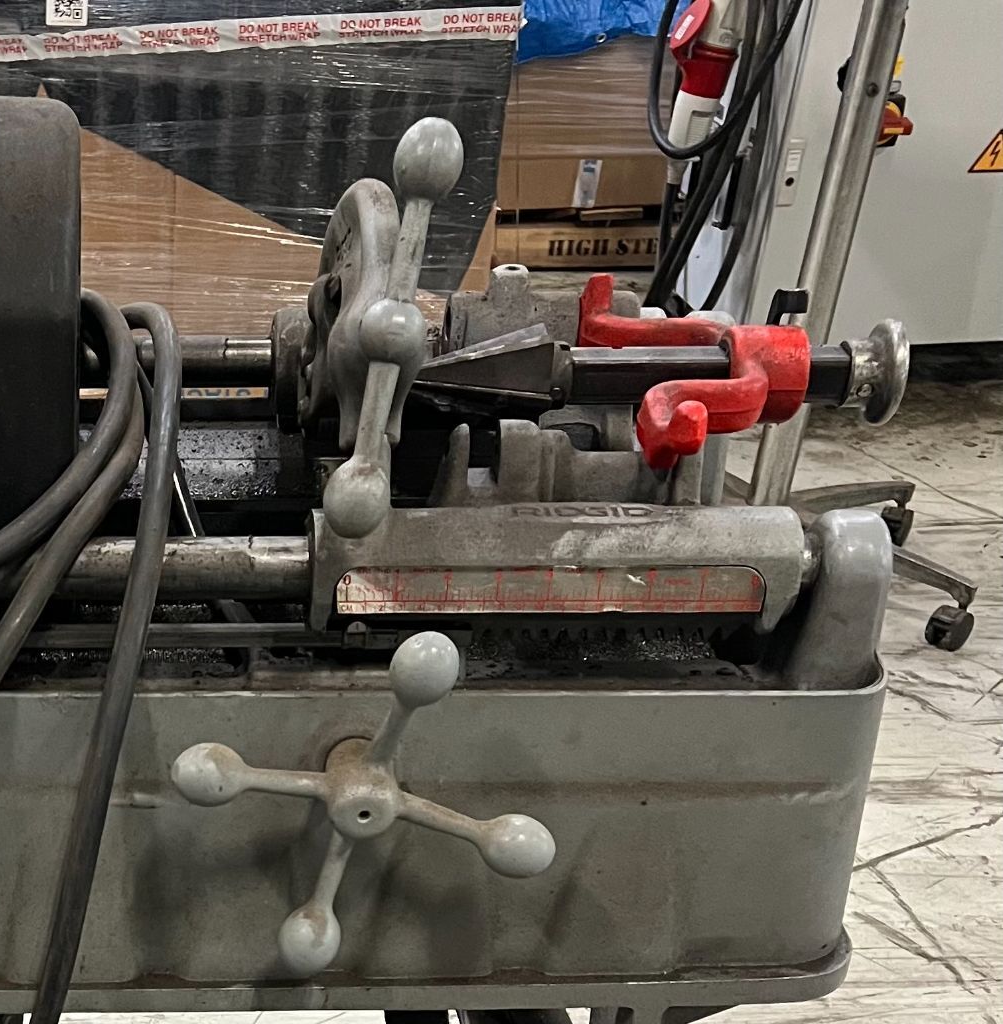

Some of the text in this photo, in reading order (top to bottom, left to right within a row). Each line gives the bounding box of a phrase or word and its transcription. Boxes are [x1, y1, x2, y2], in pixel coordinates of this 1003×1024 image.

[340, 17, 422, 29] DO NOT BREAK
[443, 15, 459, 24] DO
[462, 14, 484, 23] NOT
[139, 27, 219, 39] DO NOT BREAK
[239, 22, 319, 34] DO NOT BREAK
[493, 25, 519, 33] WRA
[238, 32, 321, 43] STRETCH WRAP
[548, 238, 659, 257] HIGH STE
[511, 503, 655, 519] RIDGID
